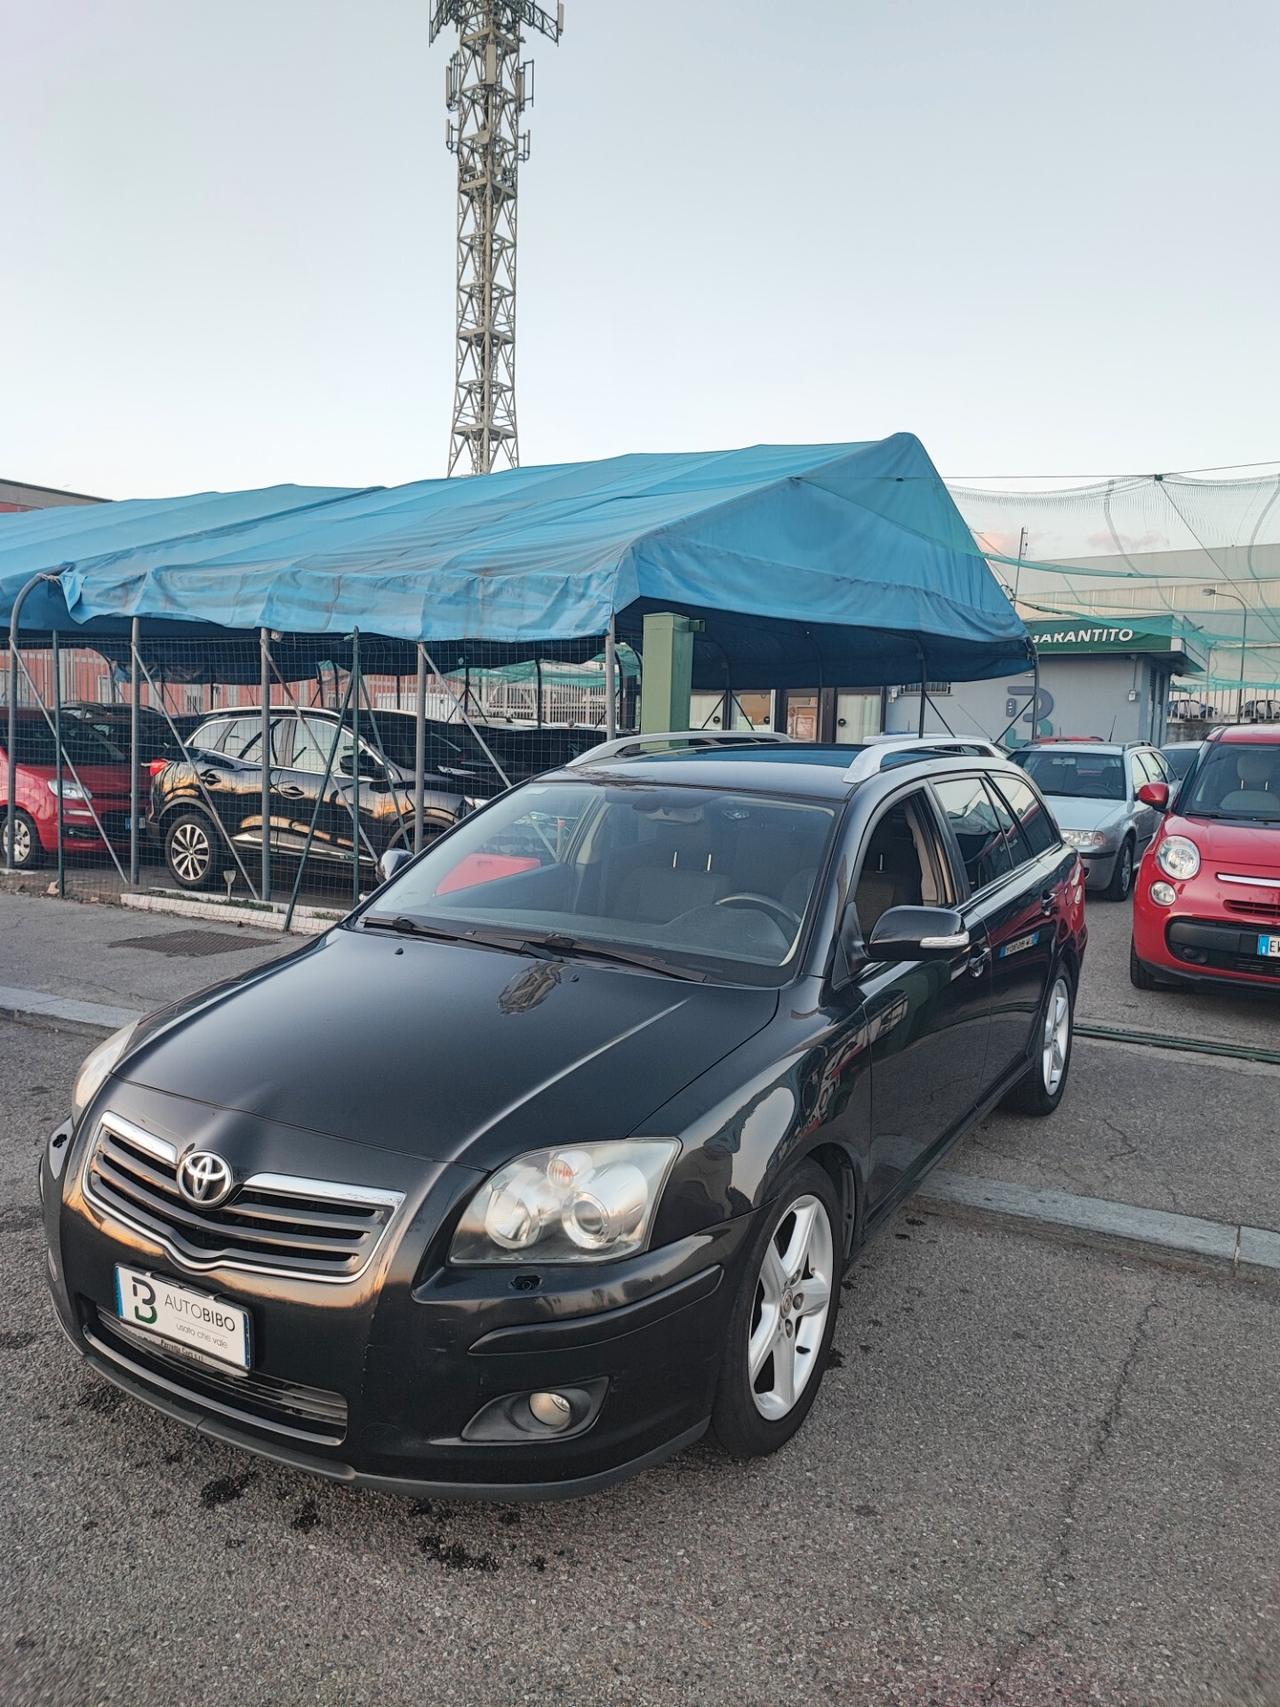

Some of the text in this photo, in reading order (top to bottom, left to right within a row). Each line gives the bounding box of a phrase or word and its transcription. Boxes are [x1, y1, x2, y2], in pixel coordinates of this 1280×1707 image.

[164, 1293, 236, 1332] AUTOBIBO
[176, 1323, 196, 1336] usato
[212, 1337, 228, 1349] vale
